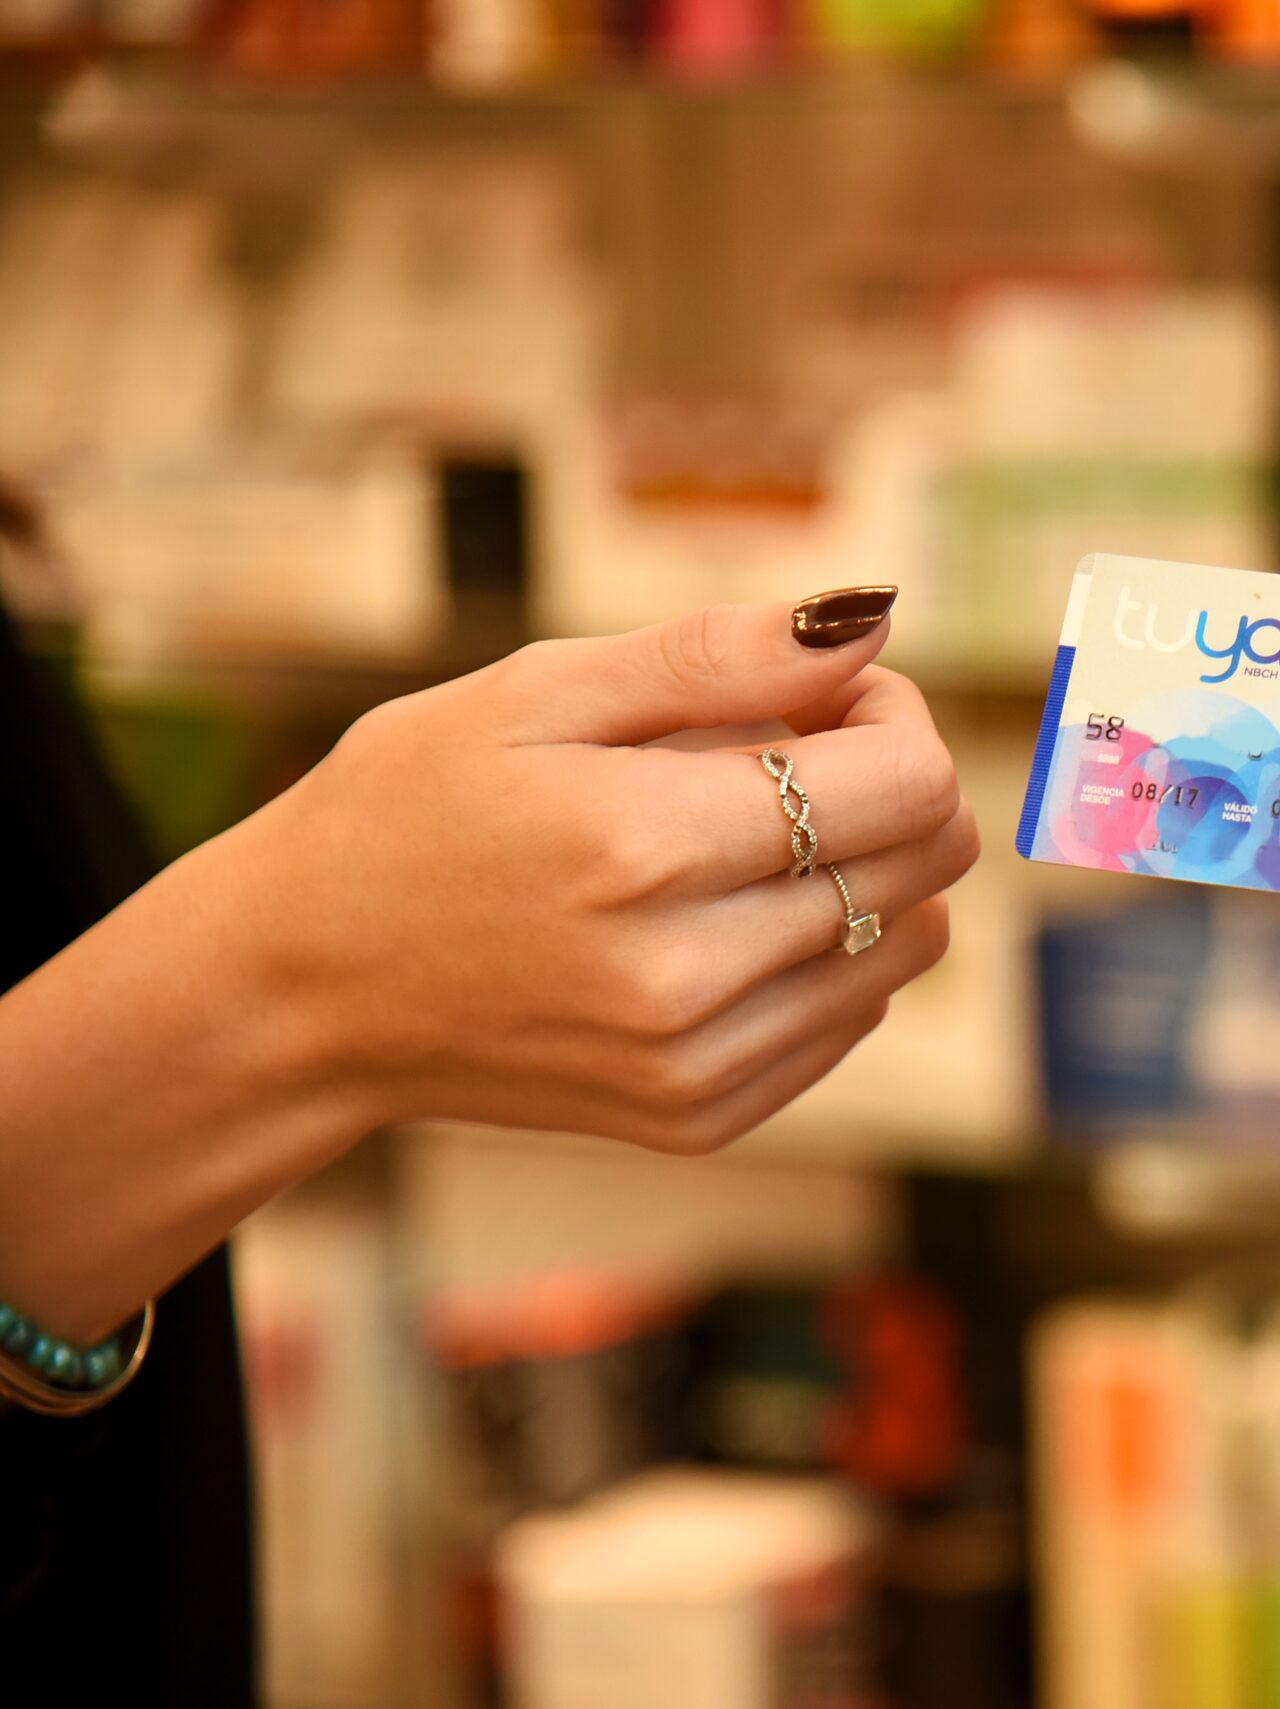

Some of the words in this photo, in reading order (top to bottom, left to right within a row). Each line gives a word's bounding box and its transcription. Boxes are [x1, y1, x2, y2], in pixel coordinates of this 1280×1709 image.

[1243, 667, 1279, 680] NBCH
[1085, 713, 1125, 743] 58
[1081, 784, 1125, 798] VIGENCIA
[1131, 782, 1200, 810] 08/17
[1079, 793, 1112, 805] DESDE
[1223, 801, 1258, 815] VÁLIDO
[1221, 812, 1252, 823] HASTA
